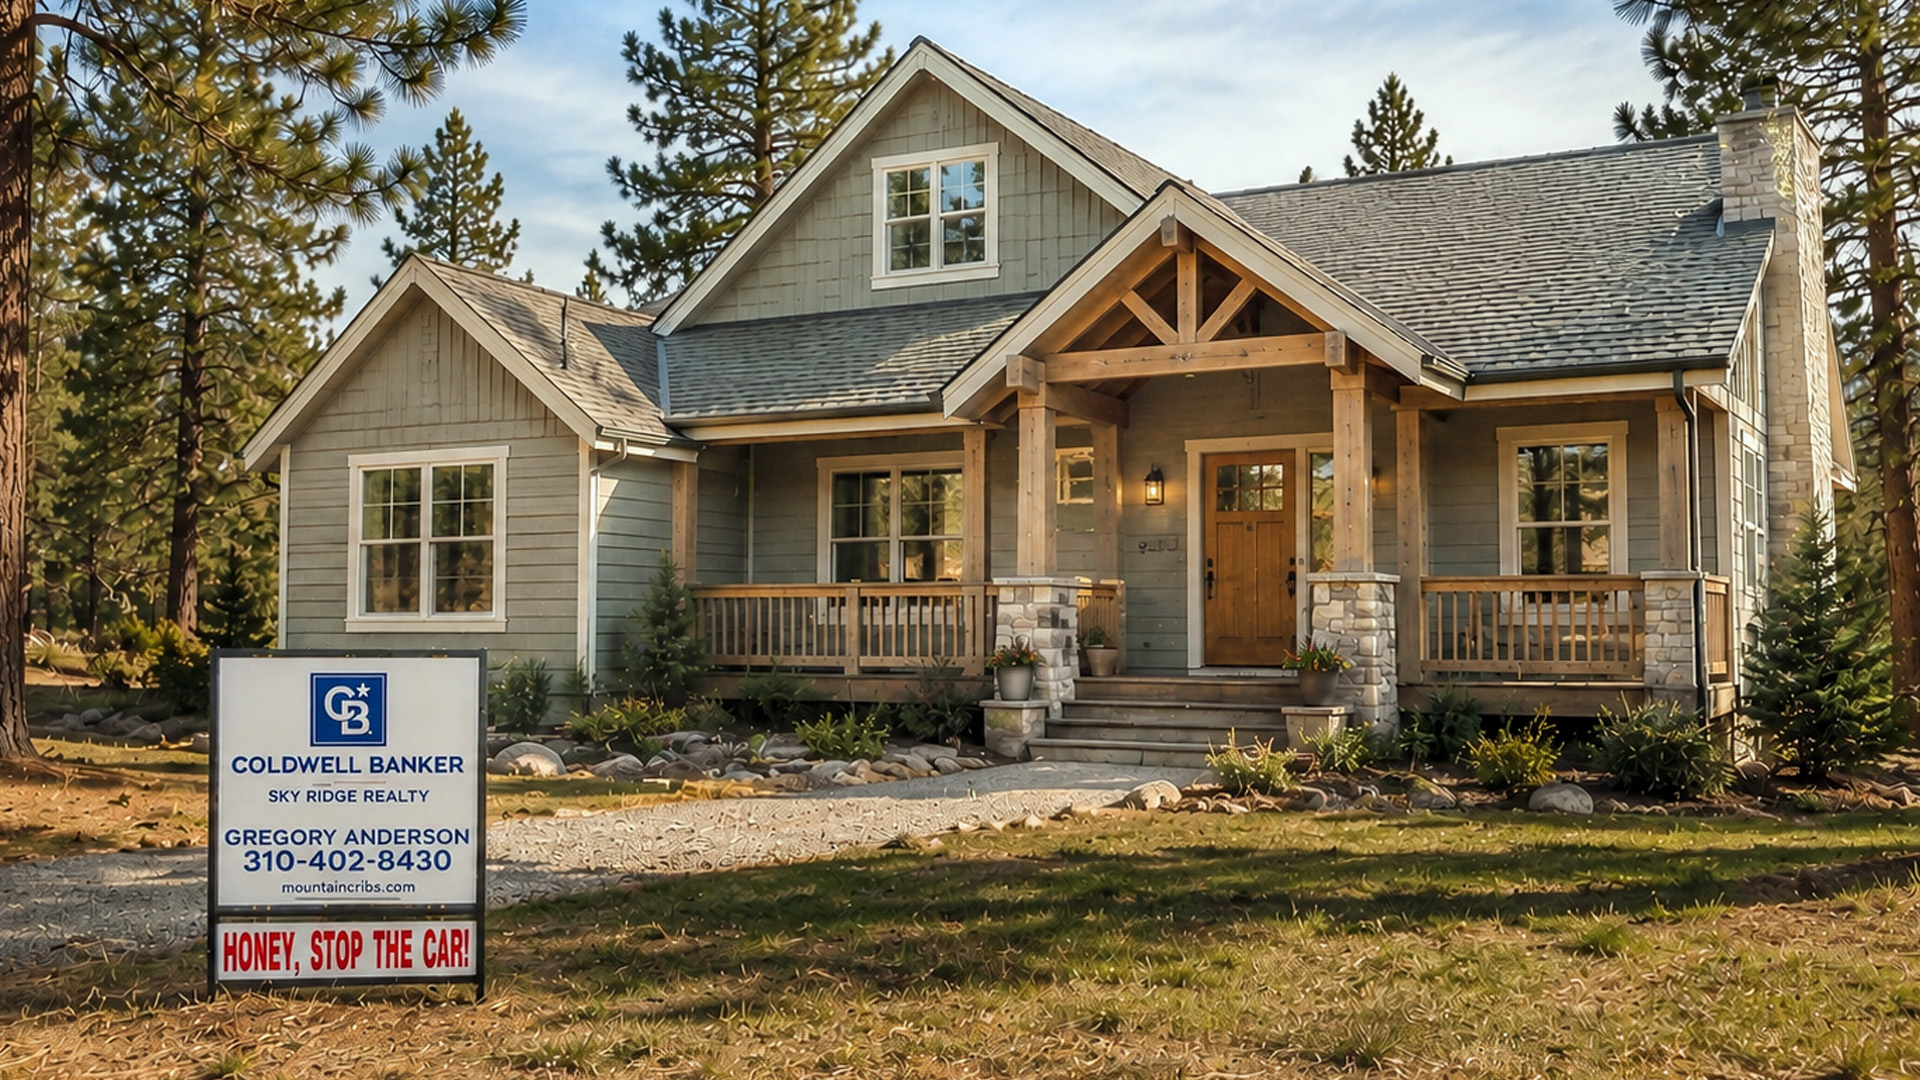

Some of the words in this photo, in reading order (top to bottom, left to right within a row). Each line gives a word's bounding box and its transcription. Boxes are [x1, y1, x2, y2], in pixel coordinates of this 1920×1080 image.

[231, 756, 362, 774] COLDWELL
[369, 756, 464, 773] BANKER
[268, 790, 300, 803] SKY
[306, 790, 357, 803] RIDGE
[363, 790, 430, 803] REALTY
[224, 829, 338, 846] GREGORY
[344, 829, 470, 845] ANDERSON
[243, 850, 452, 872] 310-402-8430
[282, 880, 415, 893] mountaincribs.com
[223, 931, 300, 976] HONEY,
[310, 930, 363, 971] STOP
[373, 929, 413, 969] THE
[423, 928, 470, 968] CAR!
